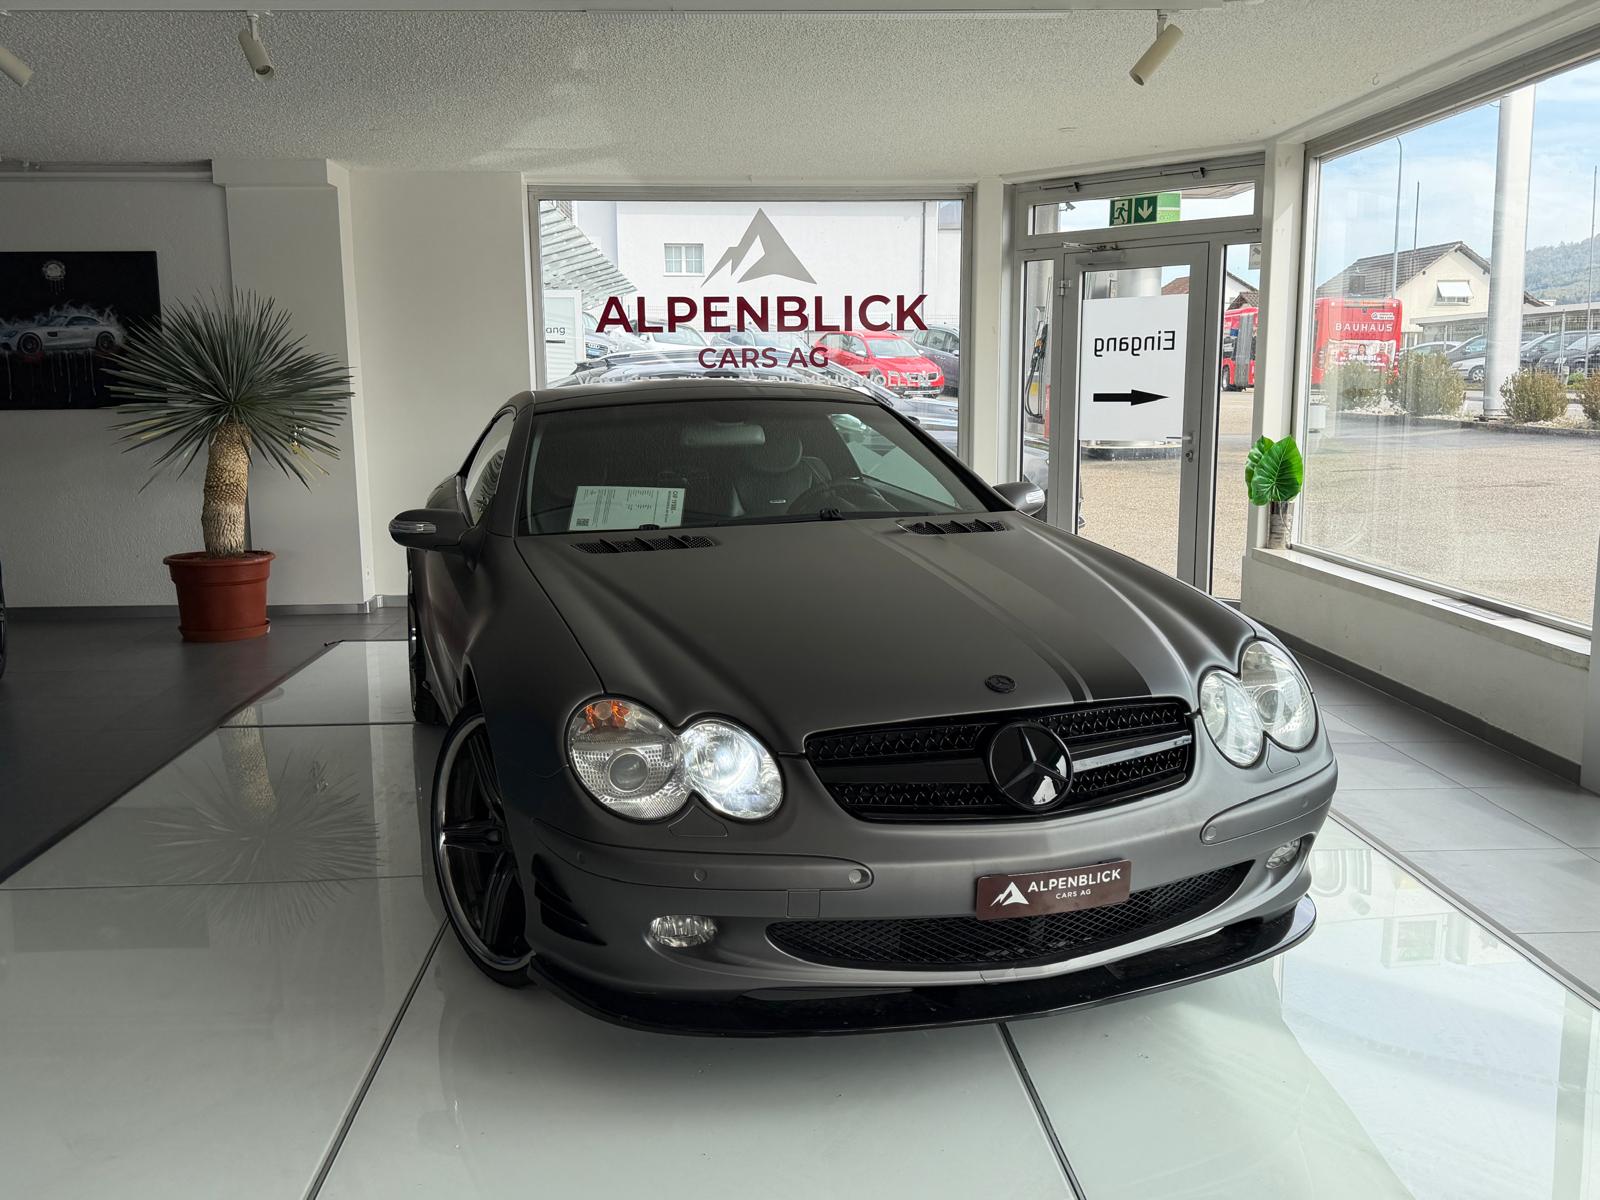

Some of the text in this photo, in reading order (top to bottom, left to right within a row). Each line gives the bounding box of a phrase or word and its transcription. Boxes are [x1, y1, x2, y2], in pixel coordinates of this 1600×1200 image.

[595, 294, 929, 333] ALPENBLICK
[1335, 322, 1393, 332] BAUHAUS
[698, 347, 829, 369] CARS AG
[1028, 868, 1121, 892] ALPENBLICK
[1056, 889, 1092, 900] CARS AG
